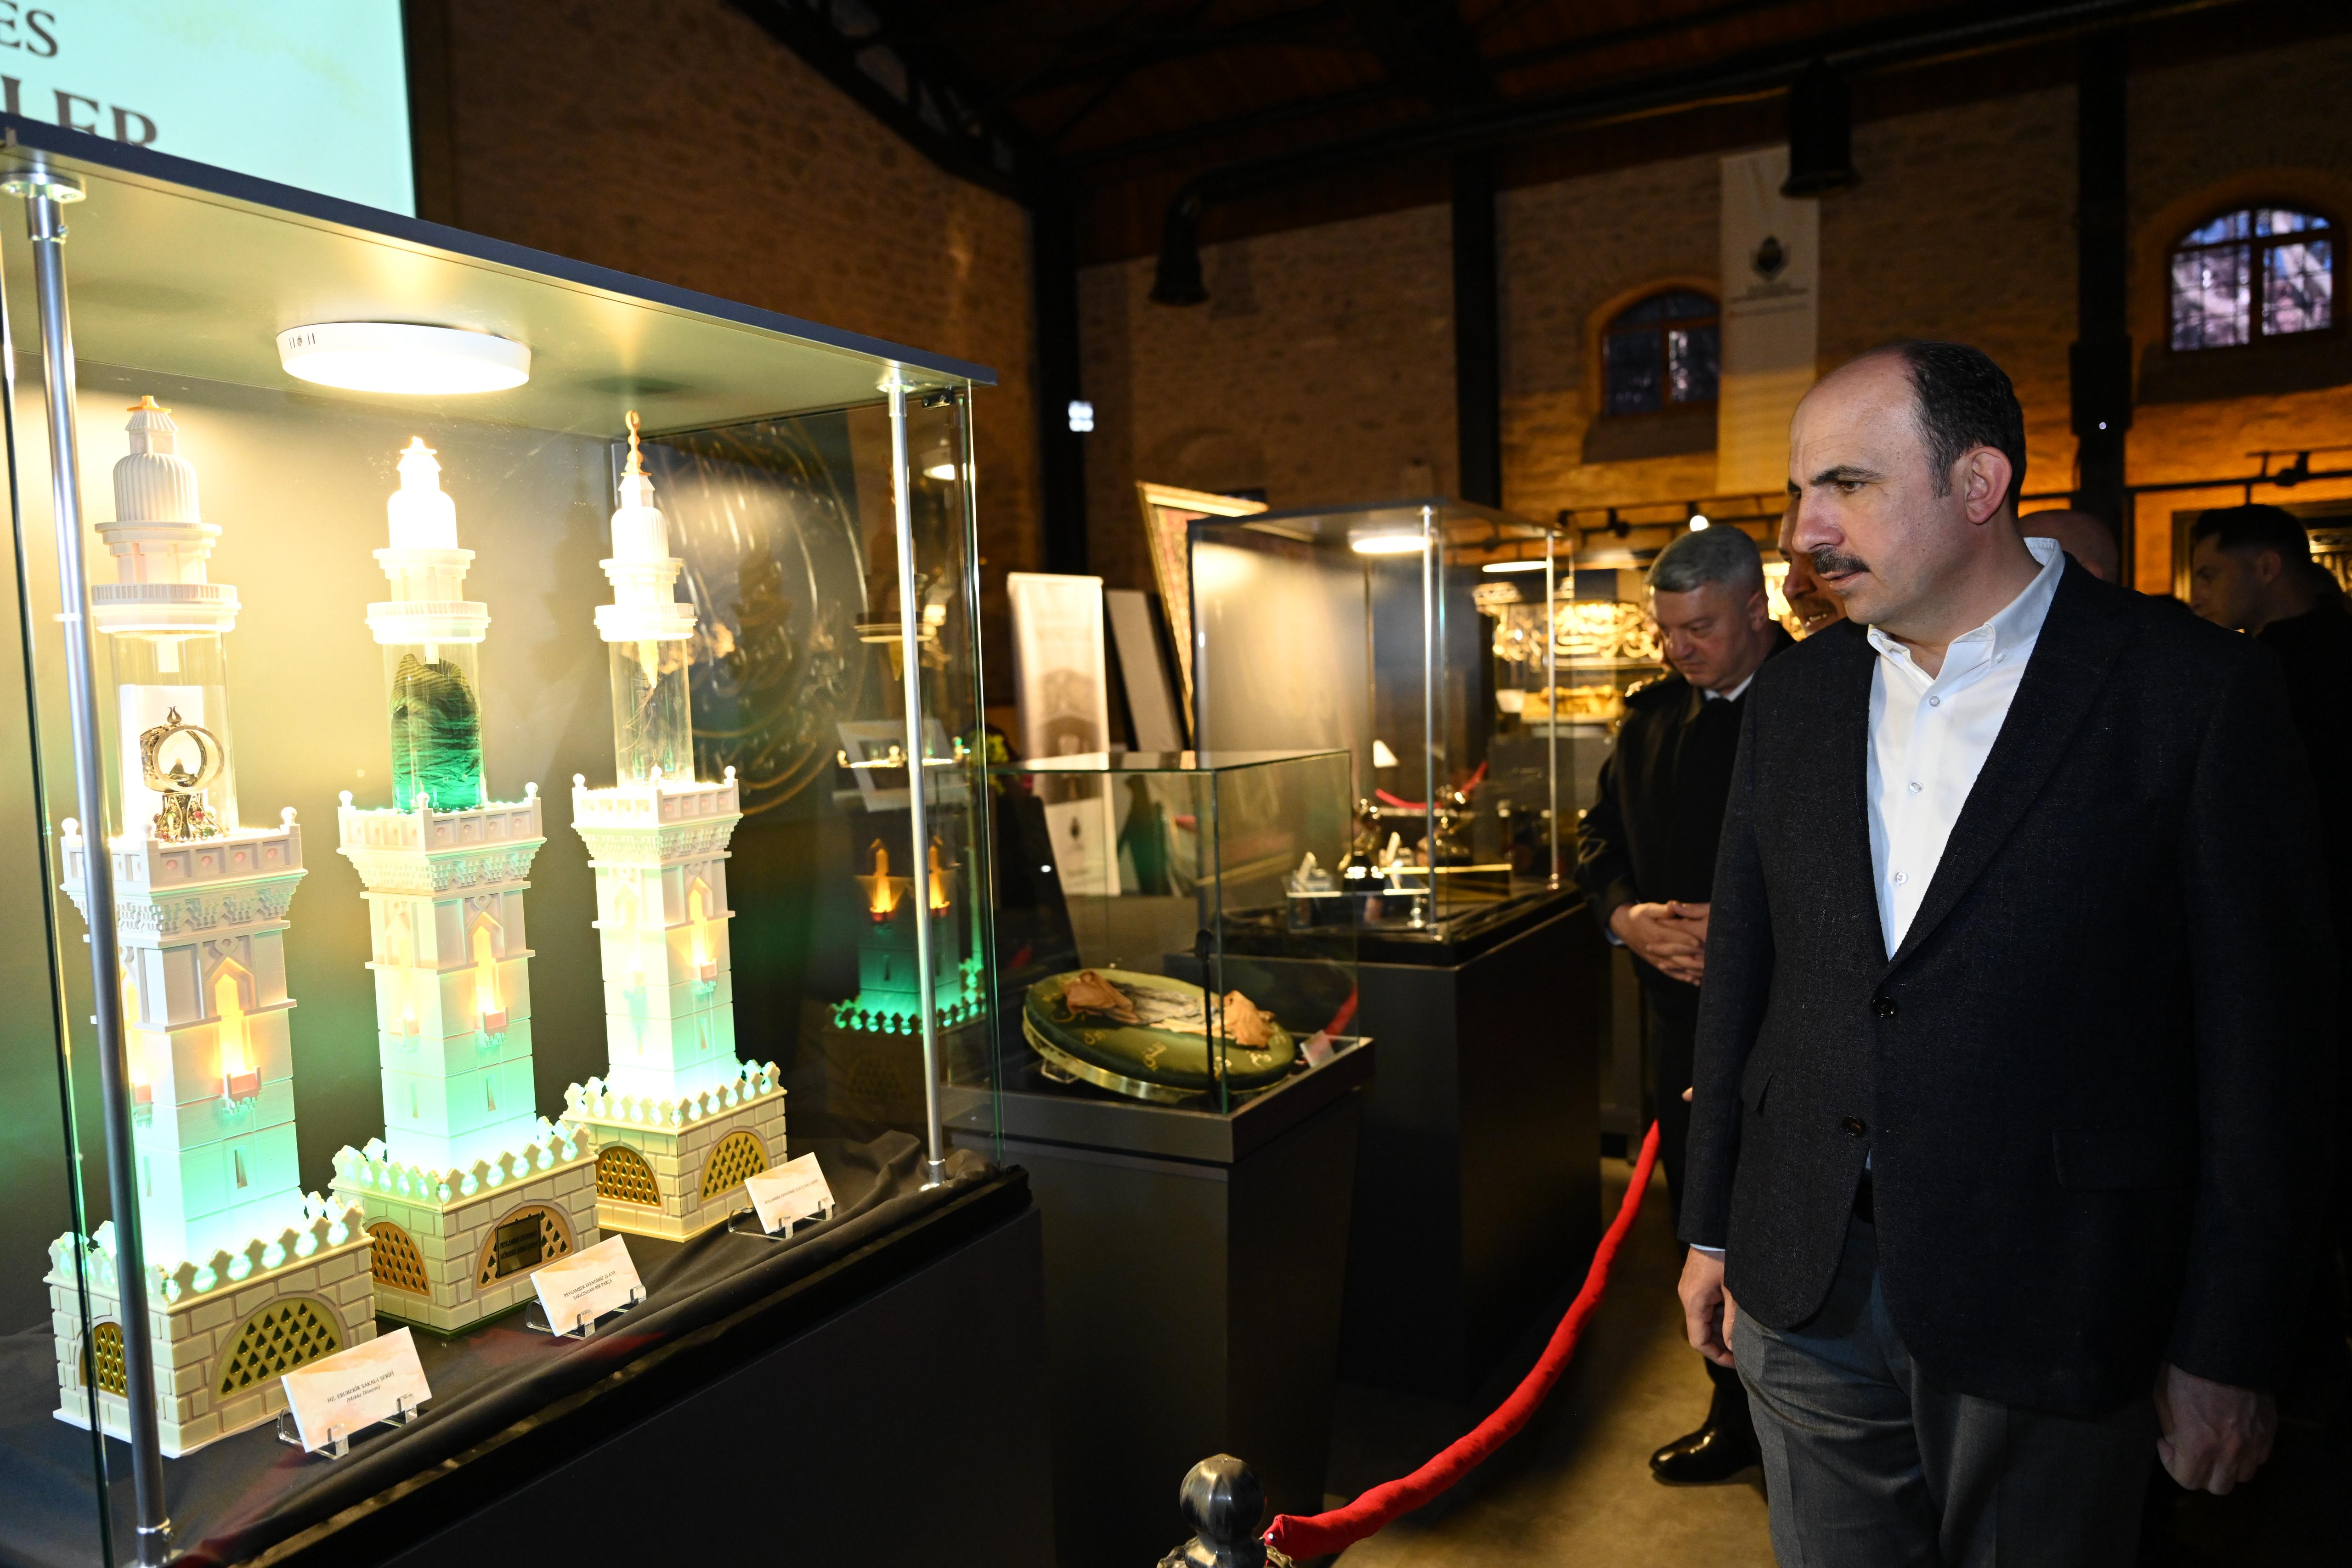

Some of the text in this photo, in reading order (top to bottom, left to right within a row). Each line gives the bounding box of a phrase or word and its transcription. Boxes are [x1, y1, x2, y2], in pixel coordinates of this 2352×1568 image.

[564, 1285, 585, 1297] PEYGAMBER
[573, 1288, 594, 1300] SARIĞINDAN
[601, 1279, 612, 1287] PARÇA
[337, 1385, 361, 1399] EBUBEKİR
[379, 1370, 394, 1382] ŞERİFİ
[346, 1385, 380, 1403] (Mekke Dönemi)
